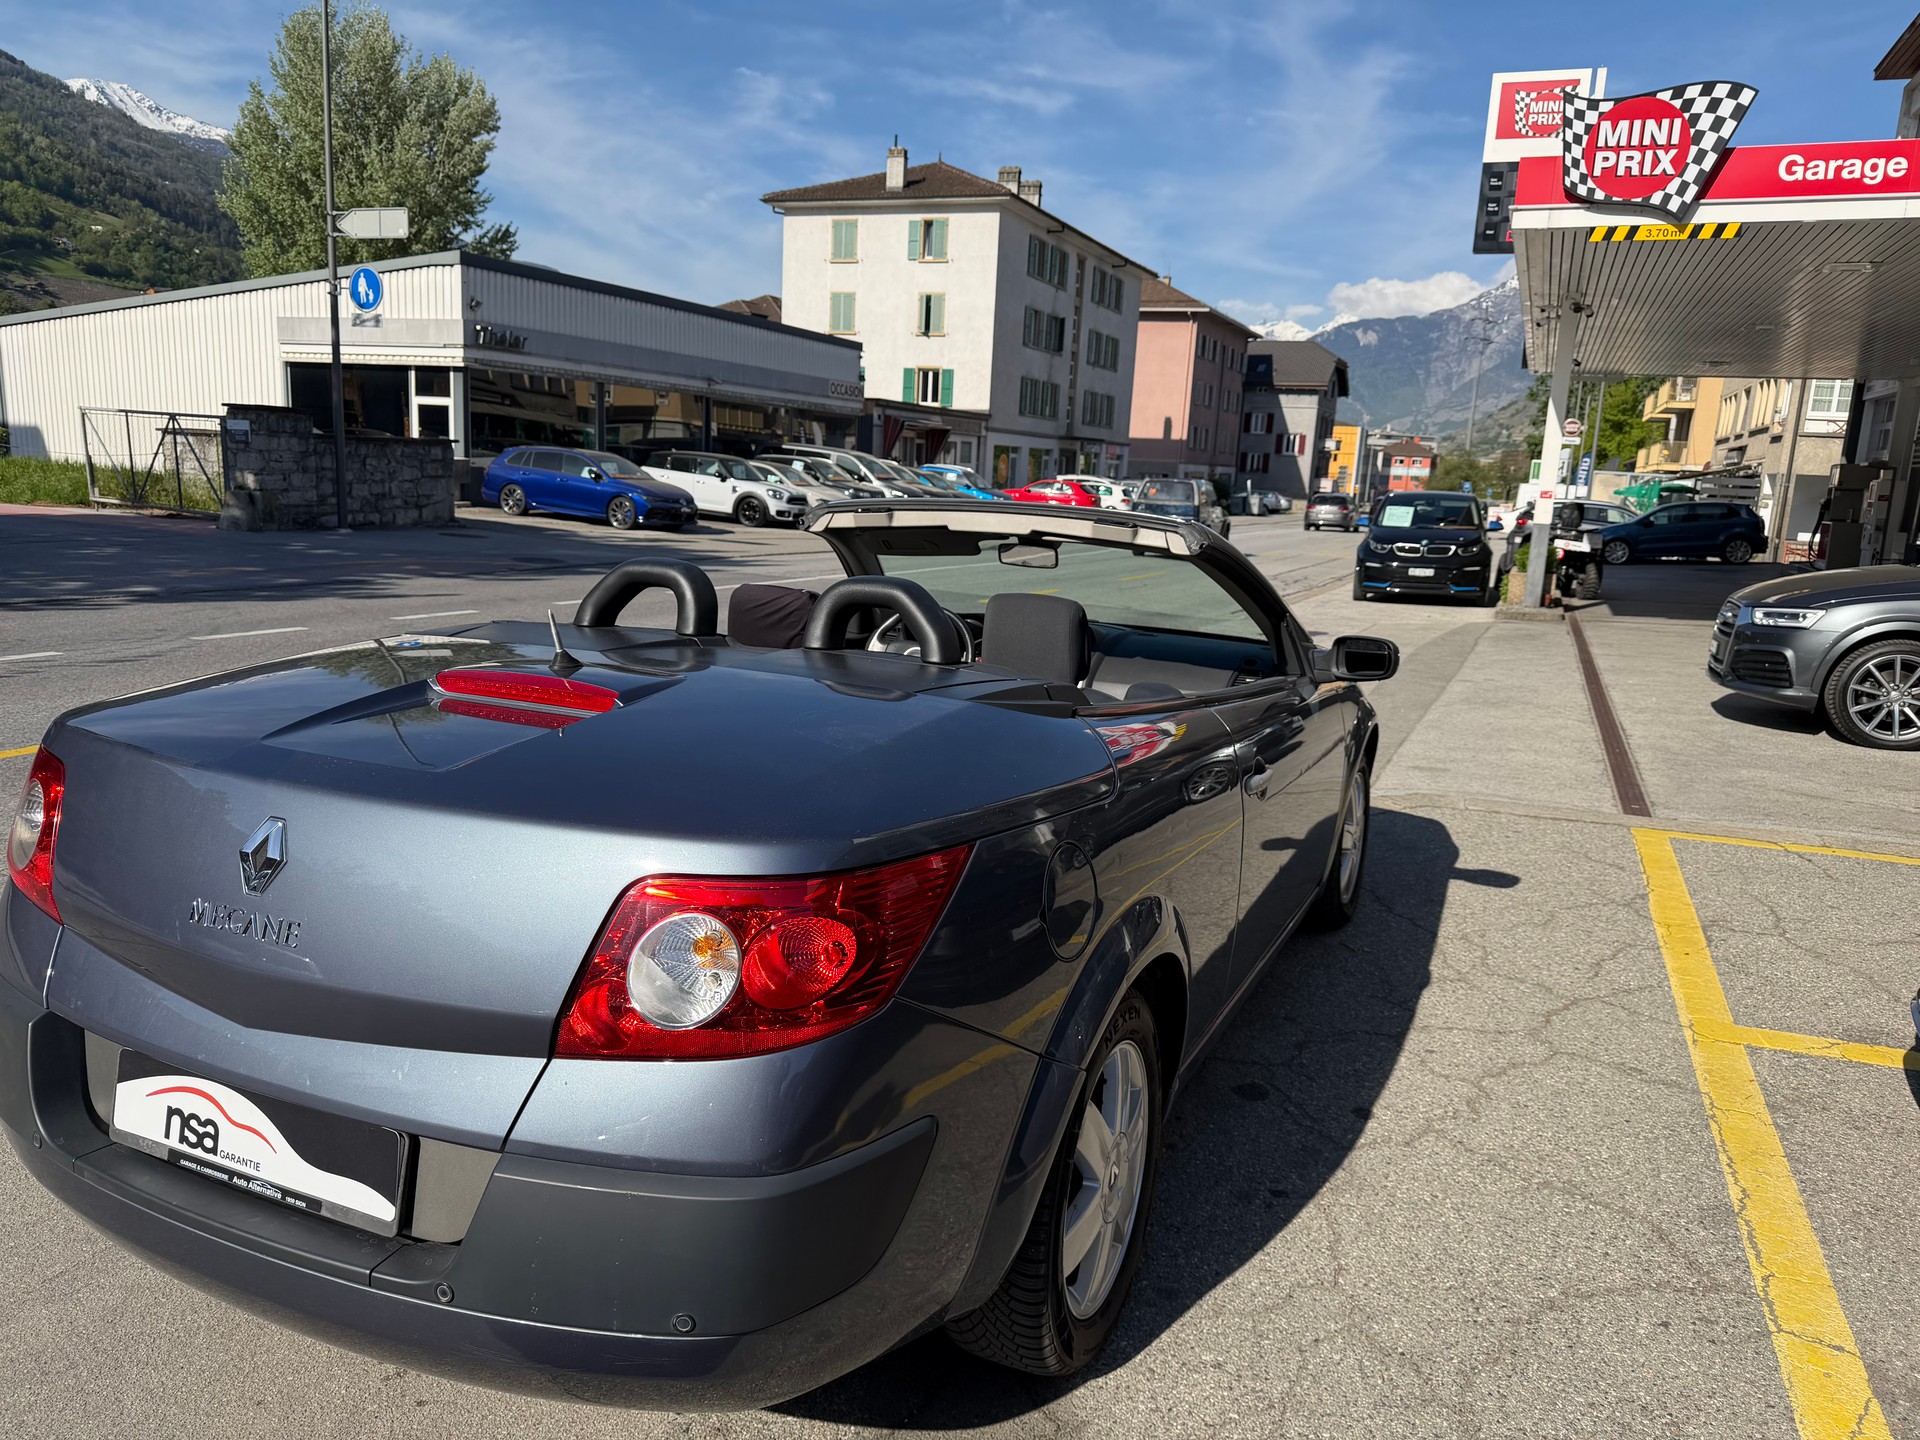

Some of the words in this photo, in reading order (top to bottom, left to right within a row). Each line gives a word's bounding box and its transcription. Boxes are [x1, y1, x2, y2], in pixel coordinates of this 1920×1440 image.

[1528, 113, 1563, 126] PRIX
[1530, 100, 1563, 113] MINI
[1596, 118, 1682, 149] MINI
[1592, 149, 1678, 178] PRIX
[1778, 154, 1909, 185] Garage
[1645, 228, 1669, 238] 3.70
[189, 898, 302, 948] MEGANE
[1103, 1005, 1141, 1050] NEXEN
[164, 1105, 219, 1157] nsa
[219, 1149, 261, 1173] GARANTIE
[232, 1175, 248, 1187] Auto
[248, 1181, 282, 1199] Alternative
